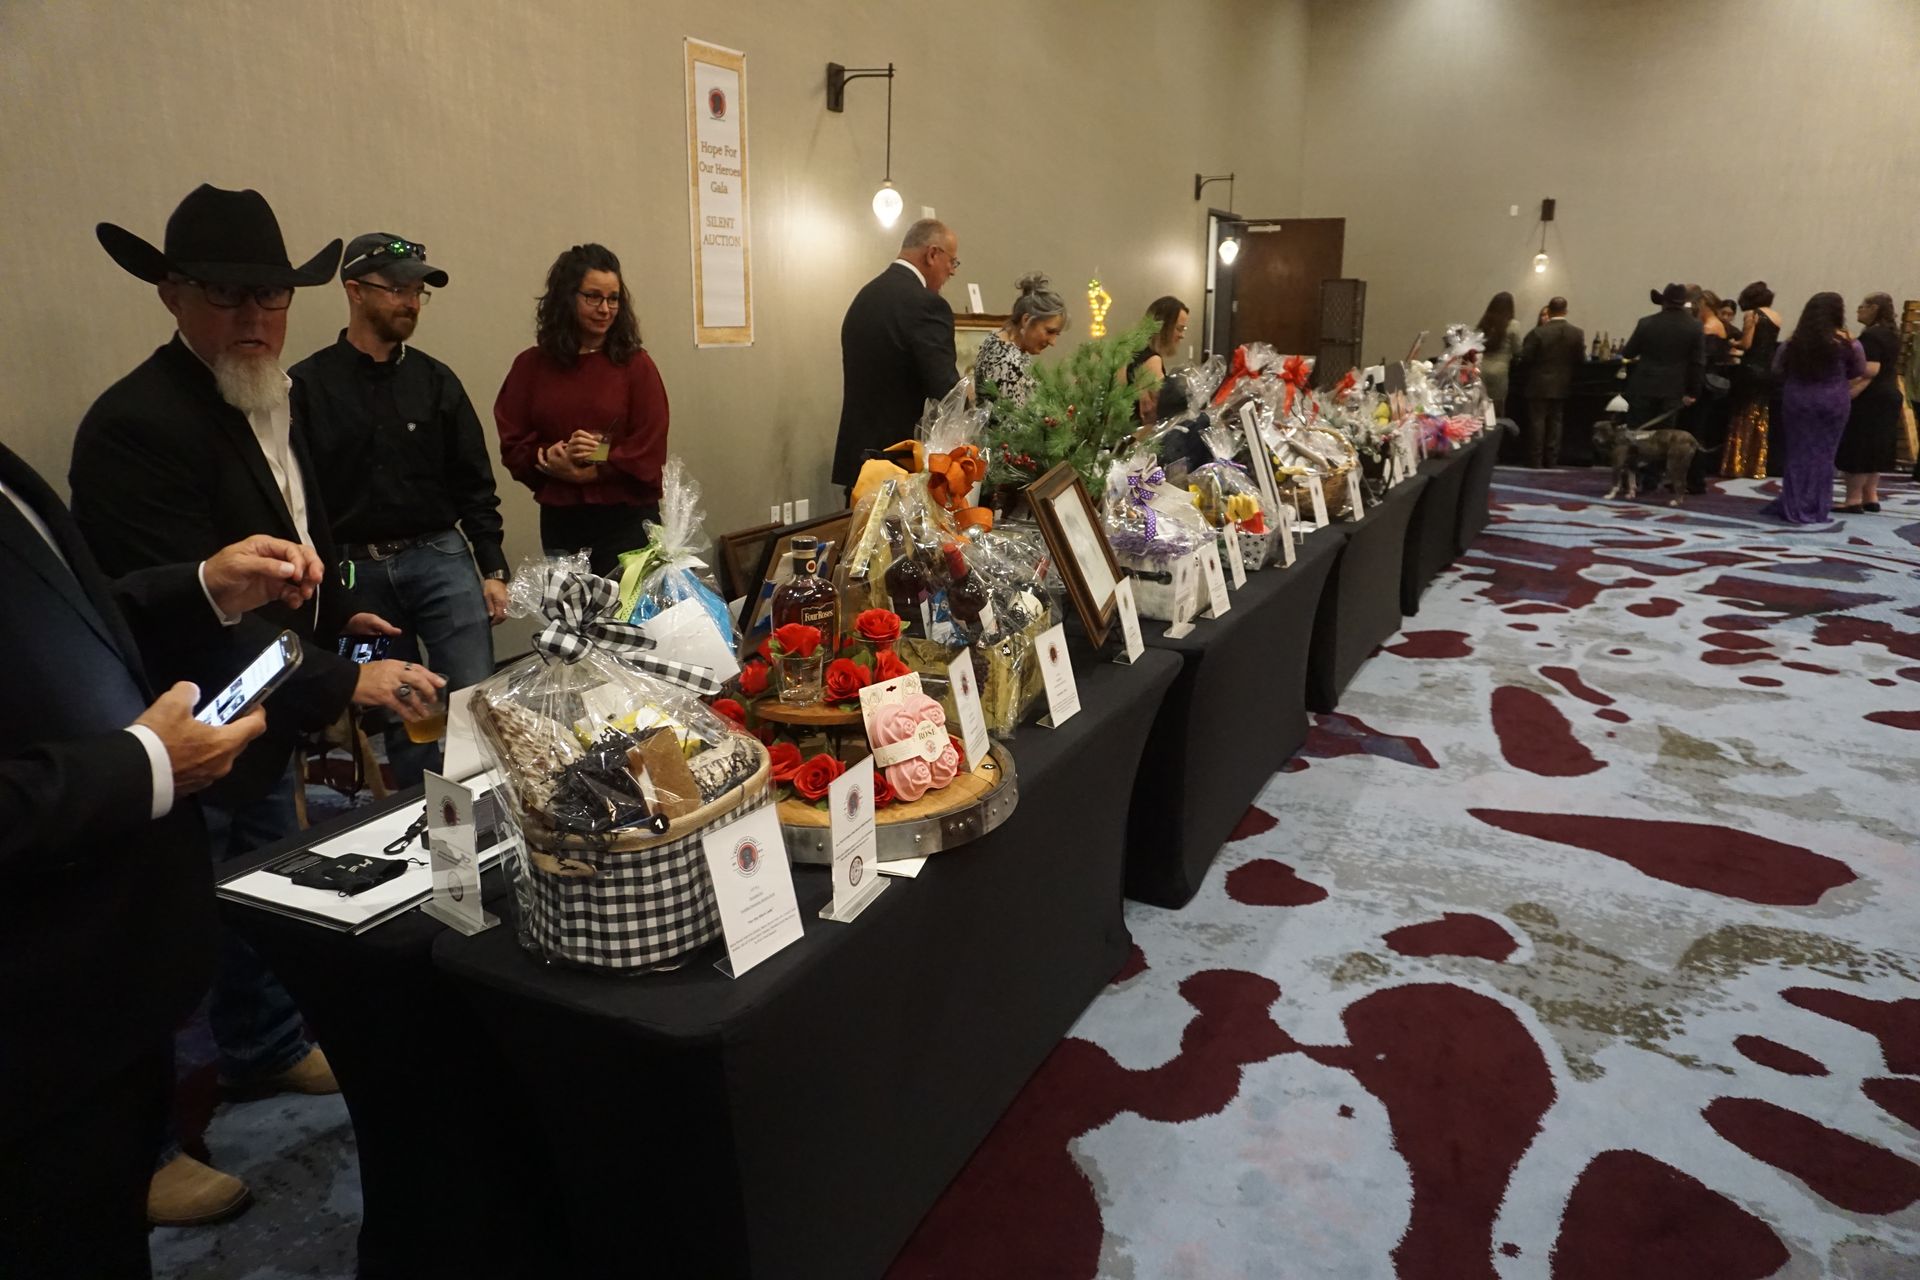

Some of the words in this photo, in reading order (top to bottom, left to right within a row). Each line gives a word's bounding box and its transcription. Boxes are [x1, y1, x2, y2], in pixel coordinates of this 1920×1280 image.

[700, 141, 723, 158] Hope
[724, 145, 738, 158] For
[699, 161, 714, 174] Our
[714, 163, 741, 177] Heroes
[710, 181, 728, 194] Gala
[706, 215, 736, 229] SILENT
[703, 234, 741, 247] AUCTION
[918, 728, 936, 740] ROSE
[654, 818, 664, 829] 1
